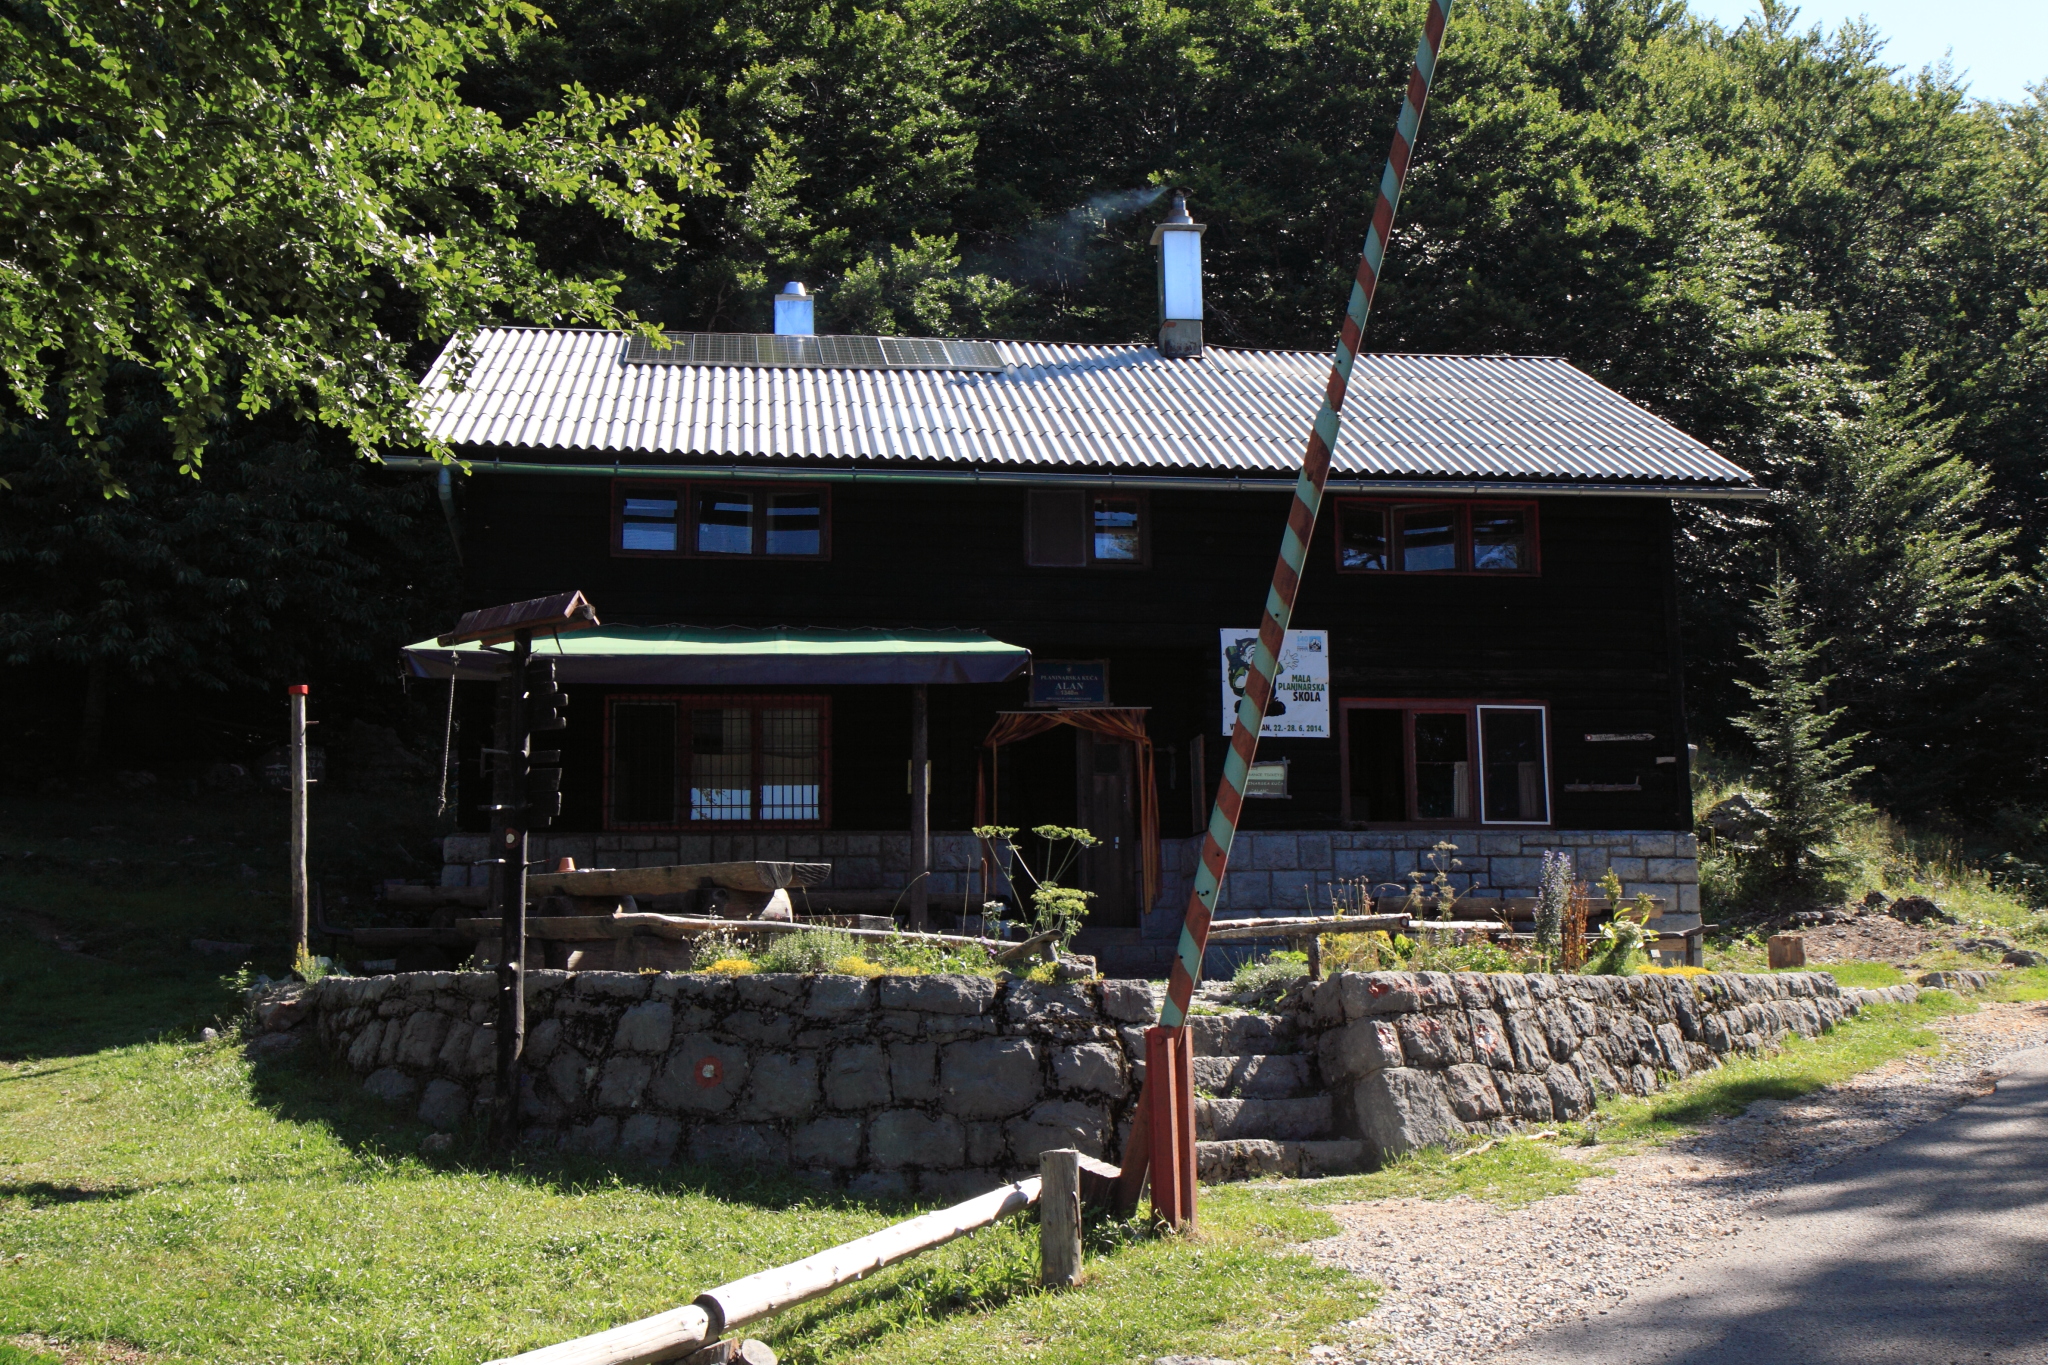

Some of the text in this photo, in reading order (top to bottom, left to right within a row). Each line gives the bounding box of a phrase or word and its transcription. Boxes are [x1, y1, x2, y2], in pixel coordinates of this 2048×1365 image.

[1291, 674, 1311, 682] MALA
[1055, 682, 1084, 690] ALAN
[1278, 683, 1325, 691] PLANINARSKA
[1293, 690, 1321, 702] ŠKOLA
[1298, 724, 1305, 732] 6.
[1306, 724, 1324, 732] 2014.
